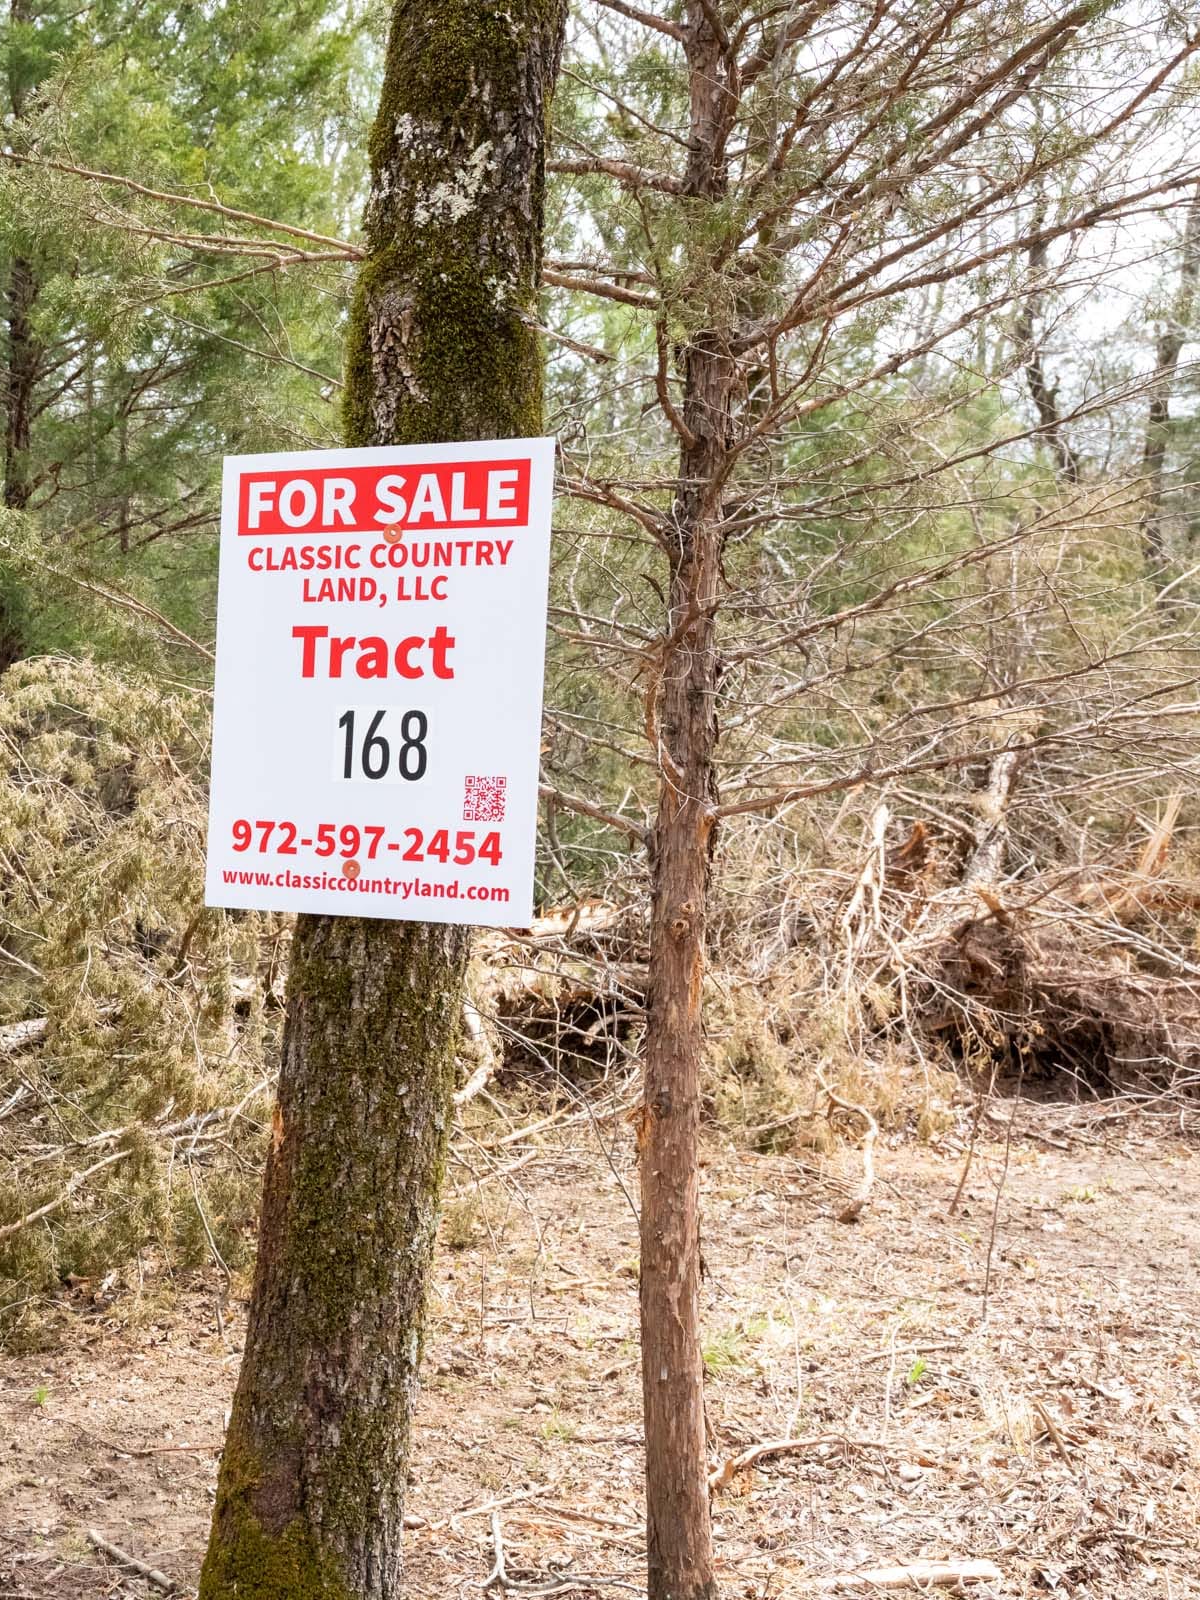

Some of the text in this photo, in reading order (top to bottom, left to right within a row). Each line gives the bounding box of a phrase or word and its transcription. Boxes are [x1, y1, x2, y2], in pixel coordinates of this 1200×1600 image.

[247, 469, 519, 529] FOR SALE
[247, 540, 514, 571] CLASSIC COUNTRY
[302, 575, 449, 608] LAND, LLC
[292, 625, 456, 680] Tract
[338, 709, 428, 782] 168
[231, 819, 503, 866] 972-597-2454
[222, 868, 511, 902] www.classiccountryland.com
